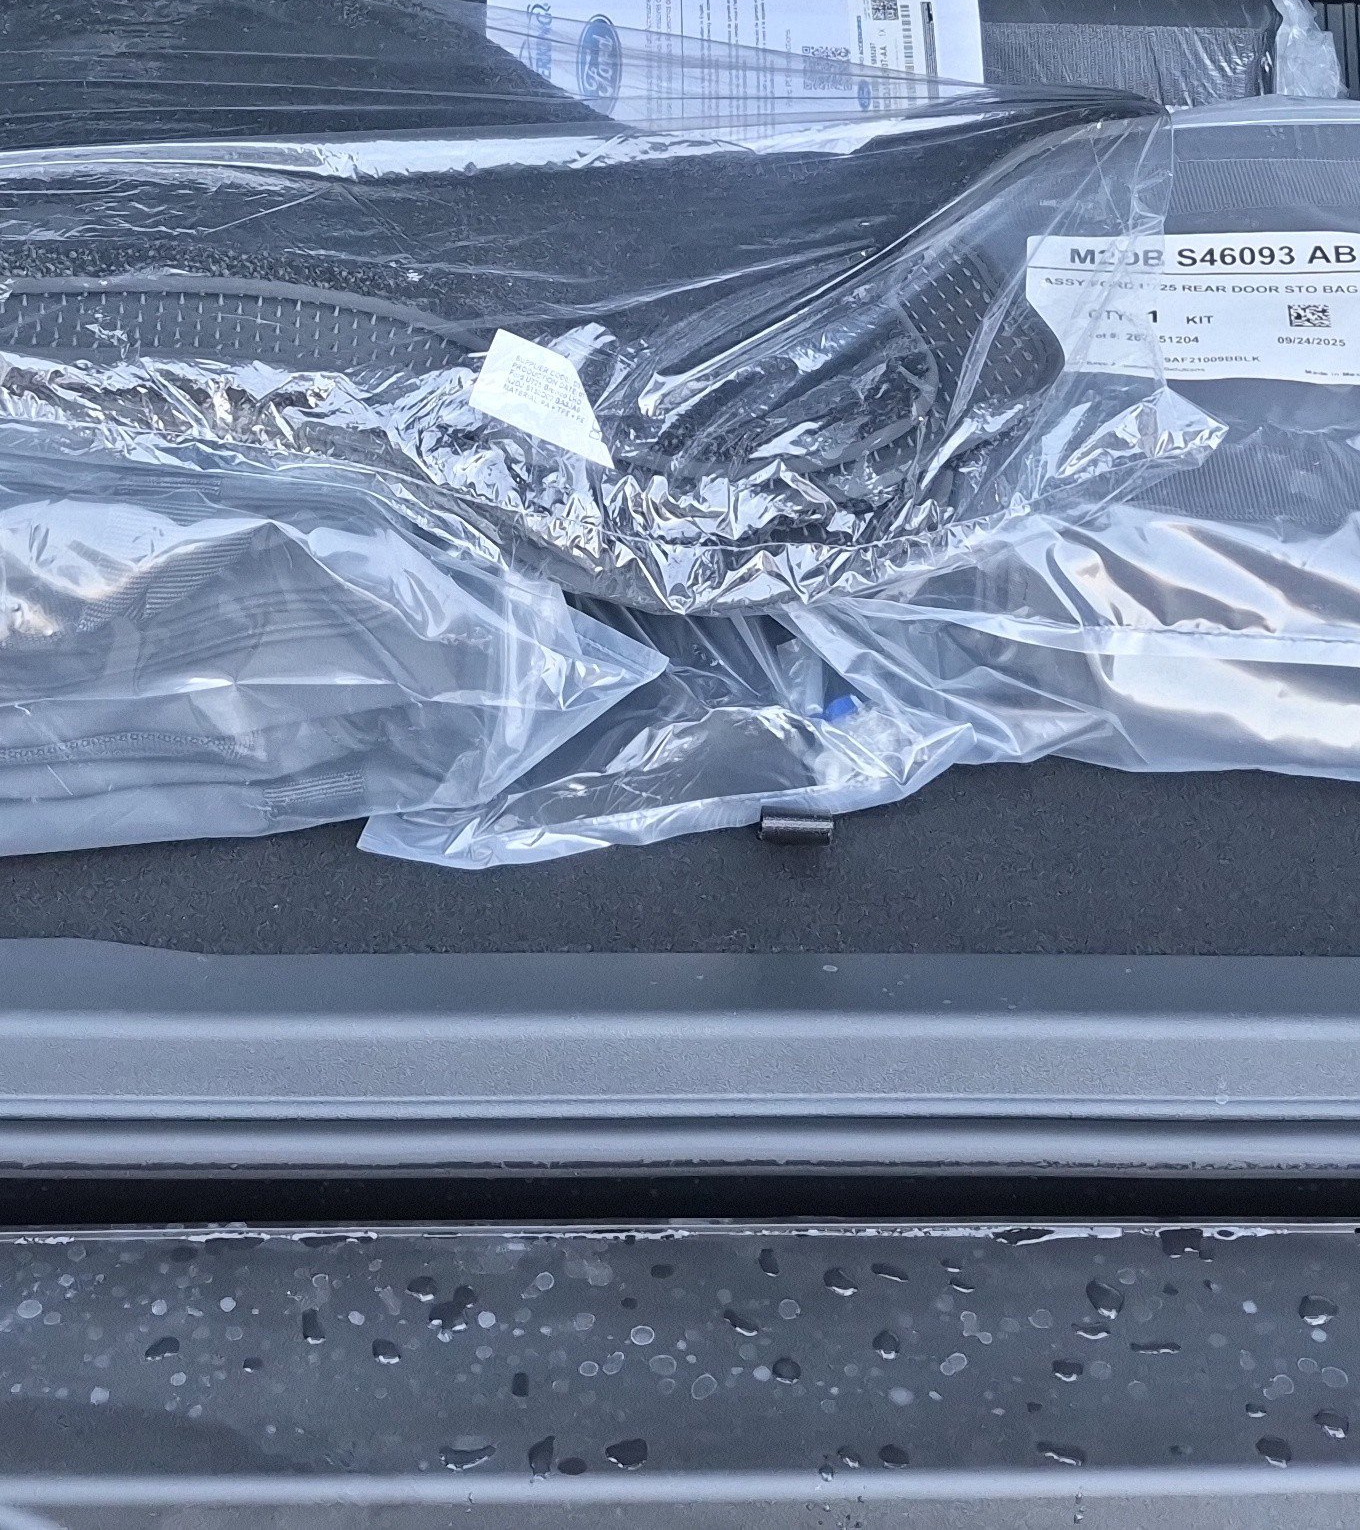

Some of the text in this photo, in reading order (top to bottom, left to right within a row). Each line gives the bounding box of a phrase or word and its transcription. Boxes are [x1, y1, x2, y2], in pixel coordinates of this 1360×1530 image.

[1177, 246, 1295, 267] S46093
[1308, 245, 1357, 264] AB
[1045, 277, 1085, 286] ASSY
[1182, 284, 1227, 293] REAR
[1232, 284, 1279, 294] DOOR
[1285, 285, 1318, 294] STO
[1323, 284, 1358, 294] BAG
[1147, 310, 1158, 323] 1
[1186, 314, 1214, 325] KIT
[1277, 336, 1346, 347] 09/24/2025
